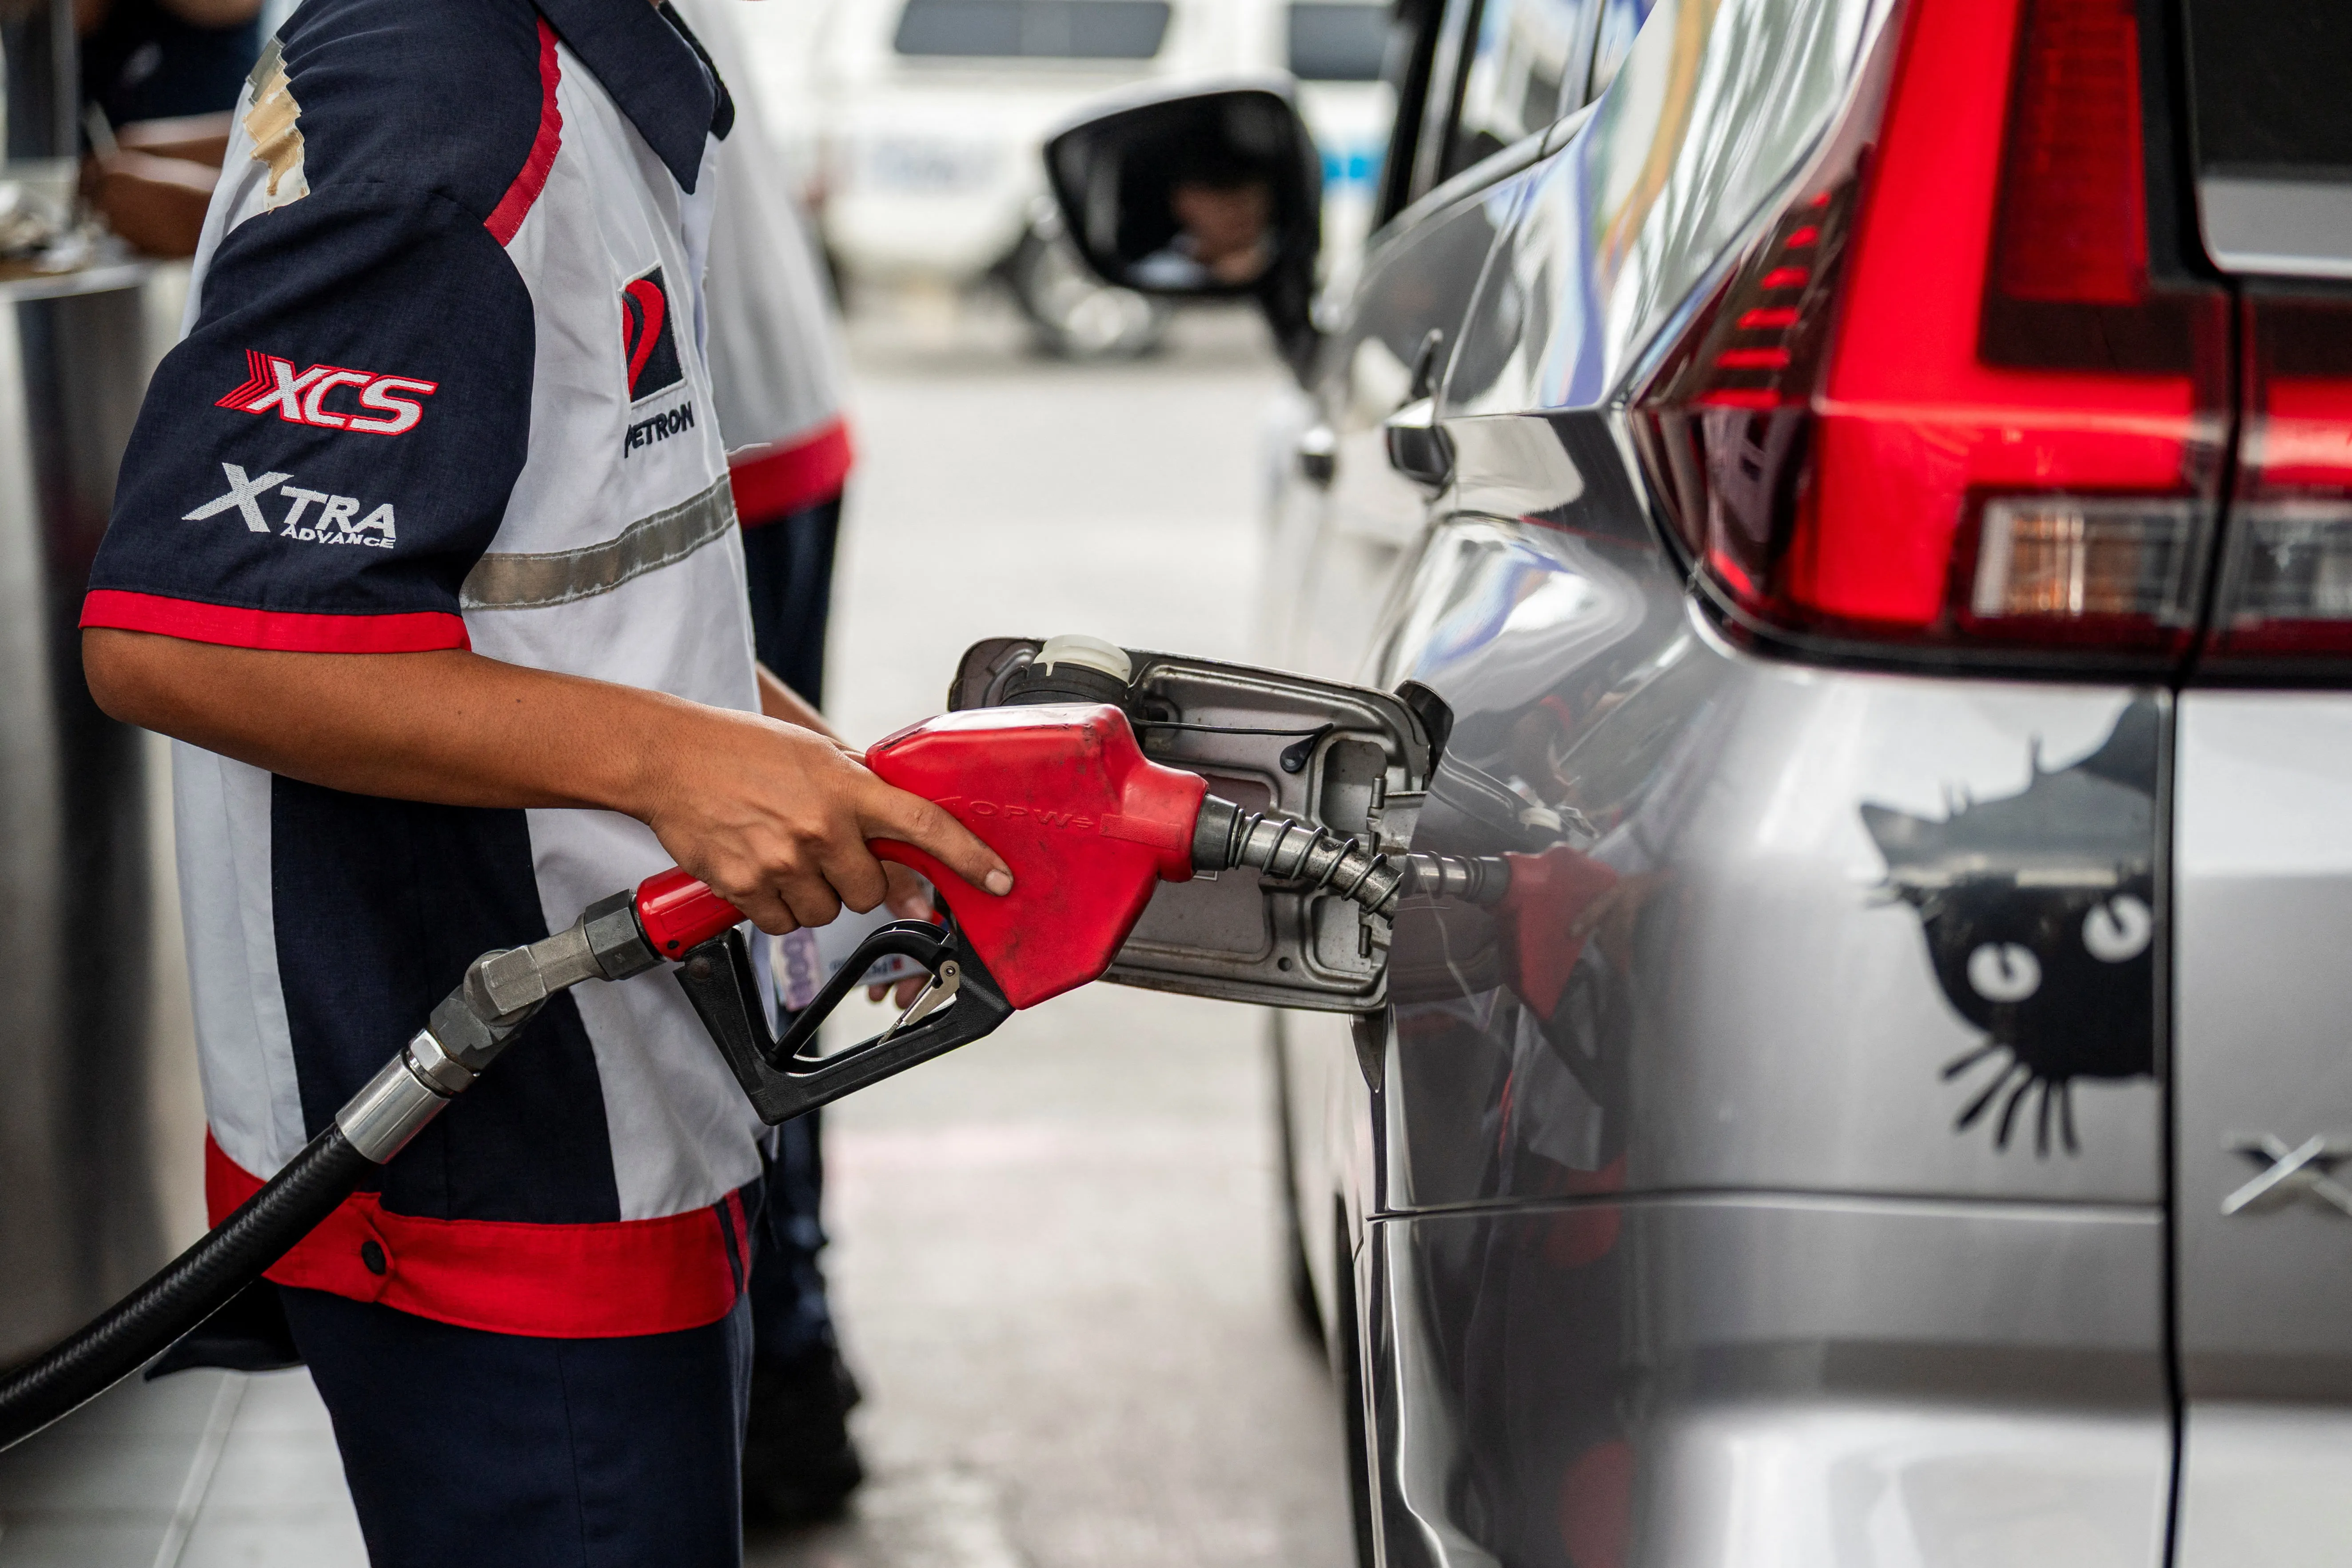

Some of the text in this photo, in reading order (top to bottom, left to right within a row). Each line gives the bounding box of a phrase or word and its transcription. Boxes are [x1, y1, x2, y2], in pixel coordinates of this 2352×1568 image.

[243, 355, 439, 436] XCS
[181, 463, 396, 539] XTRA
[280, 524, 395, 549] ADVANCE
[969, 801, 1072, 829] OPW
